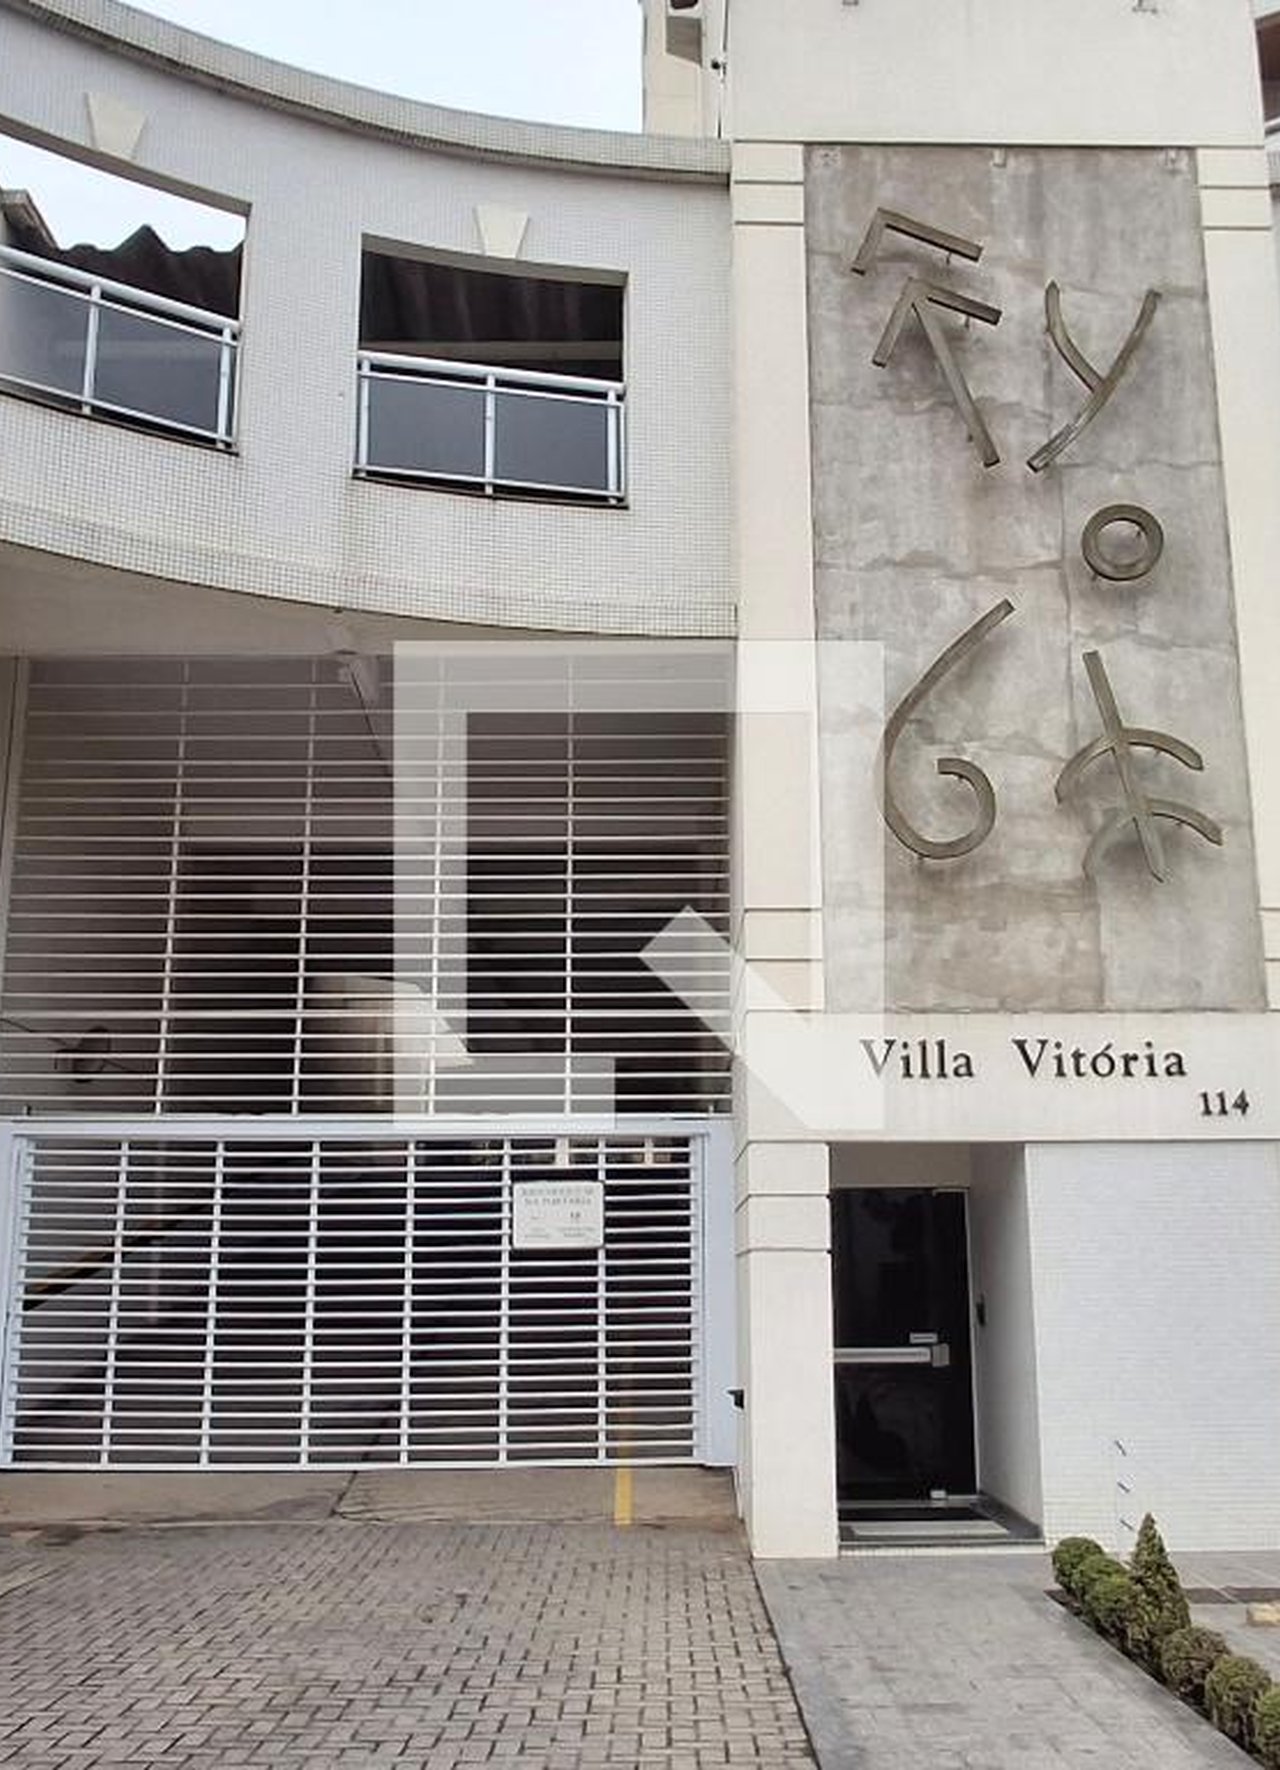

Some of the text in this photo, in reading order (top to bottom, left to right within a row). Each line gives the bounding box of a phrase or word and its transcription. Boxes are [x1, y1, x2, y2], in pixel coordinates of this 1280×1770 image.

[860, 1039, 1187, 1079] Villa Vitória
[1199, 1089, 1251, 1116] 114
